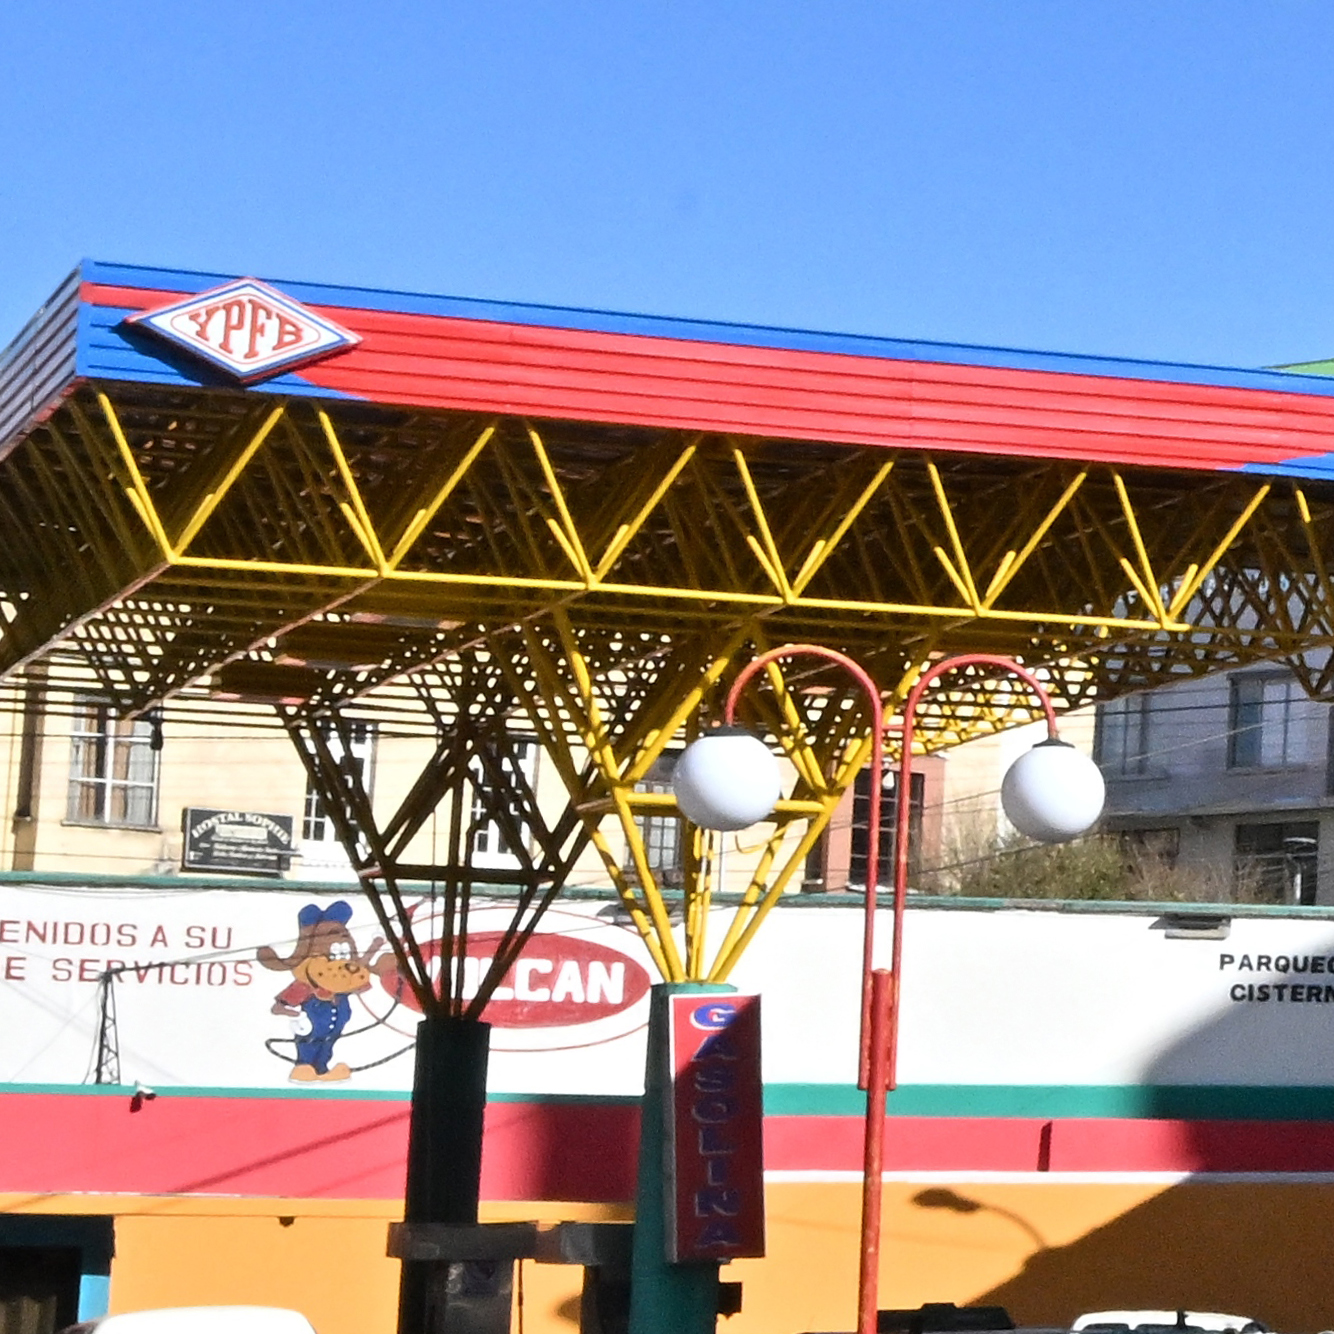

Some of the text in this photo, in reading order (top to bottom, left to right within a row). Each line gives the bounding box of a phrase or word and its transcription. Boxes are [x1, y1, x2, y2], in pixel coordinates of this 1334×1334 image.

[188, 299, 304, 359] YPFB
[0, 919, 232, 950] ENIDOS A SU
[51, 958, 253, 987] SERVICIOS
[689, 1002, 741, 1249] GASOLINA
